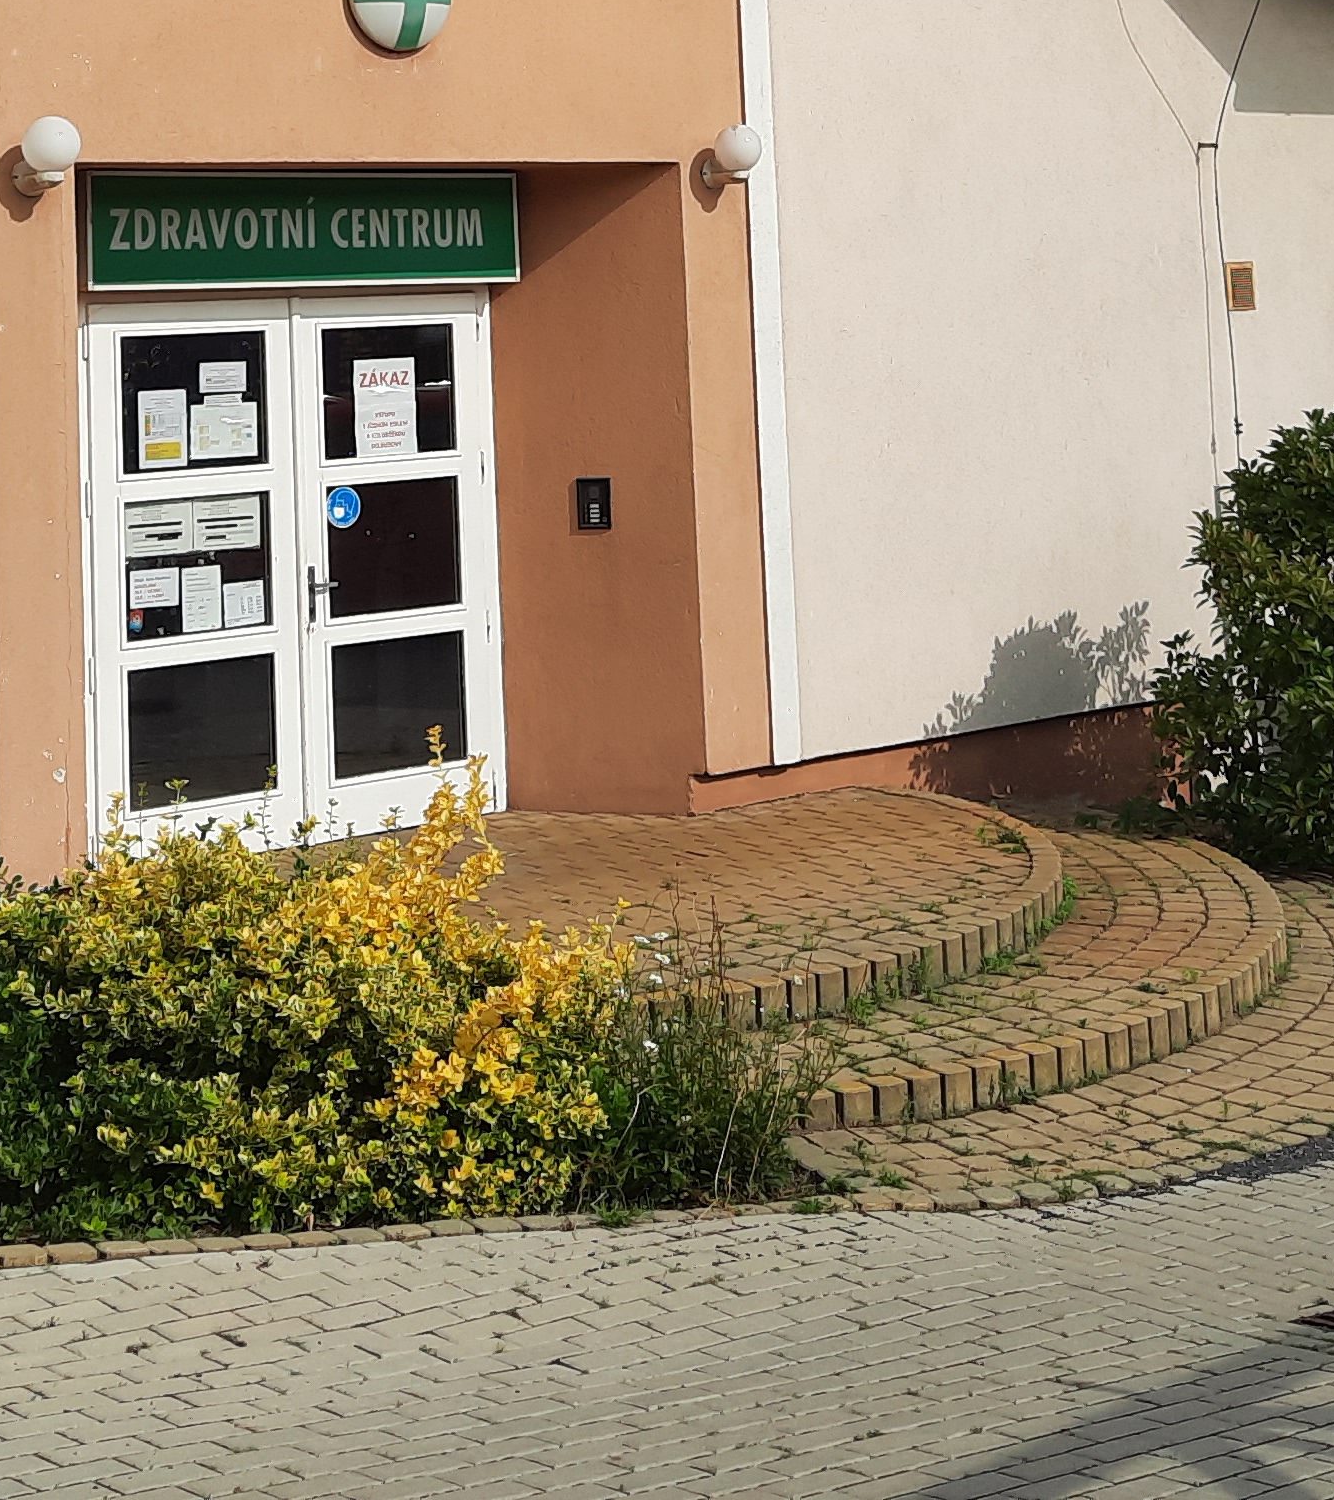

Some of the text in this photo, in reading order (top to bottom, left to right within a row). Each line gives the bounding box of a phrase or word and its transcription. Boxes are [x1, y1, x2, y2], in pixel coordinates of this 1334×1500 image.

[109, 196, 485, 251] ZDRAVOTNÍ CENTRUM
[358, 367, 410, 389] ZÁKAZ
